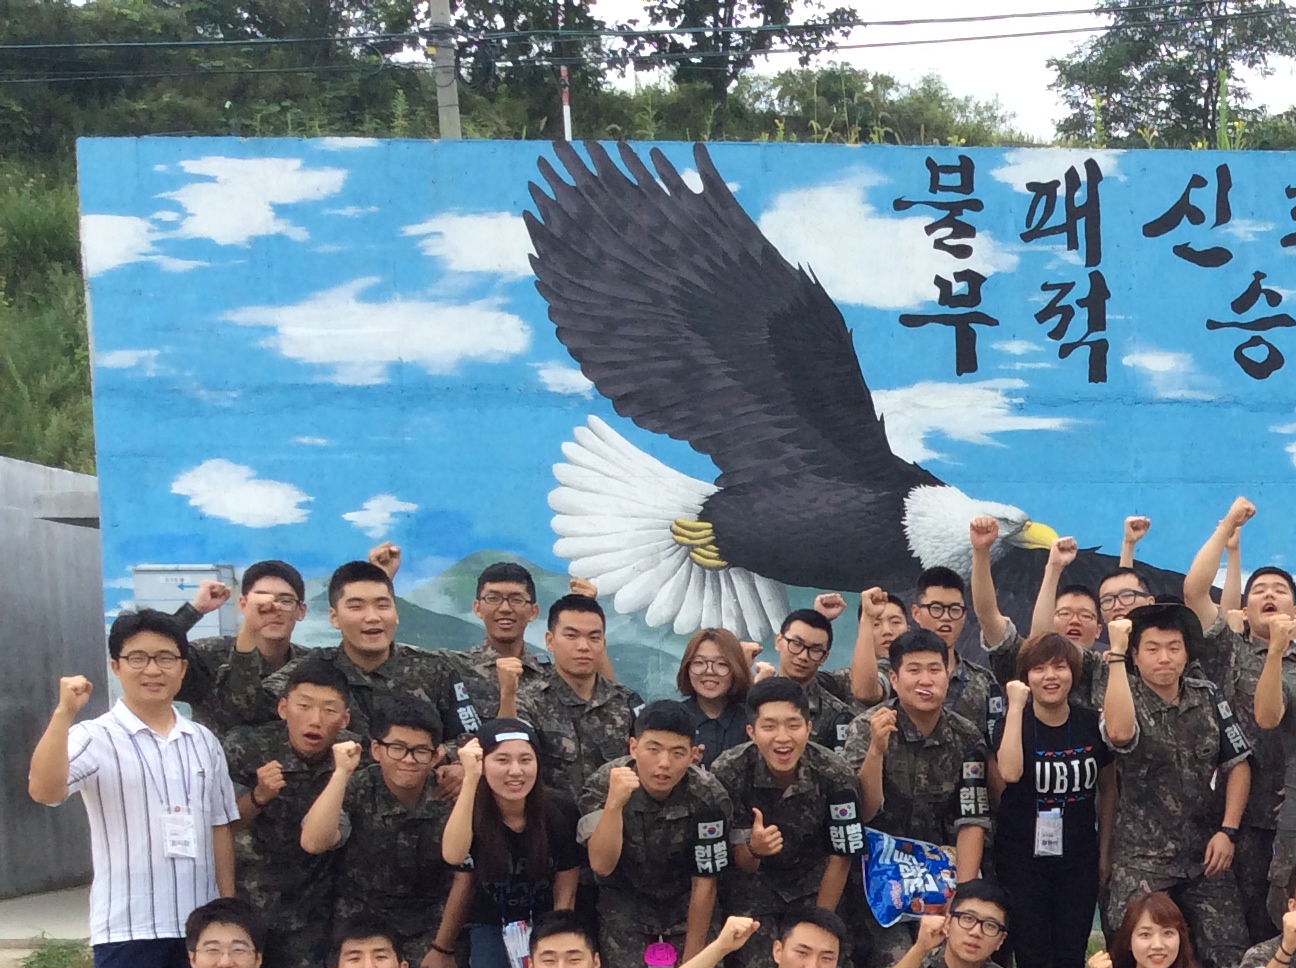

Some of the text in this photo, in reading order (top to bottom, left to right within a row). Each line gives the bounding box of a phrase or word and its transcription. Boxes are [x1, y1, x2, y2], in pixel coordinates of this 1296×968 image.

[960, 803, 990, 816] MP
[829, 822, 864, 843] 헌병
[694, 840, 728, 862] 헌병
[832, 840, 864, 854] MP
[696, 858, 729, 873] MP
